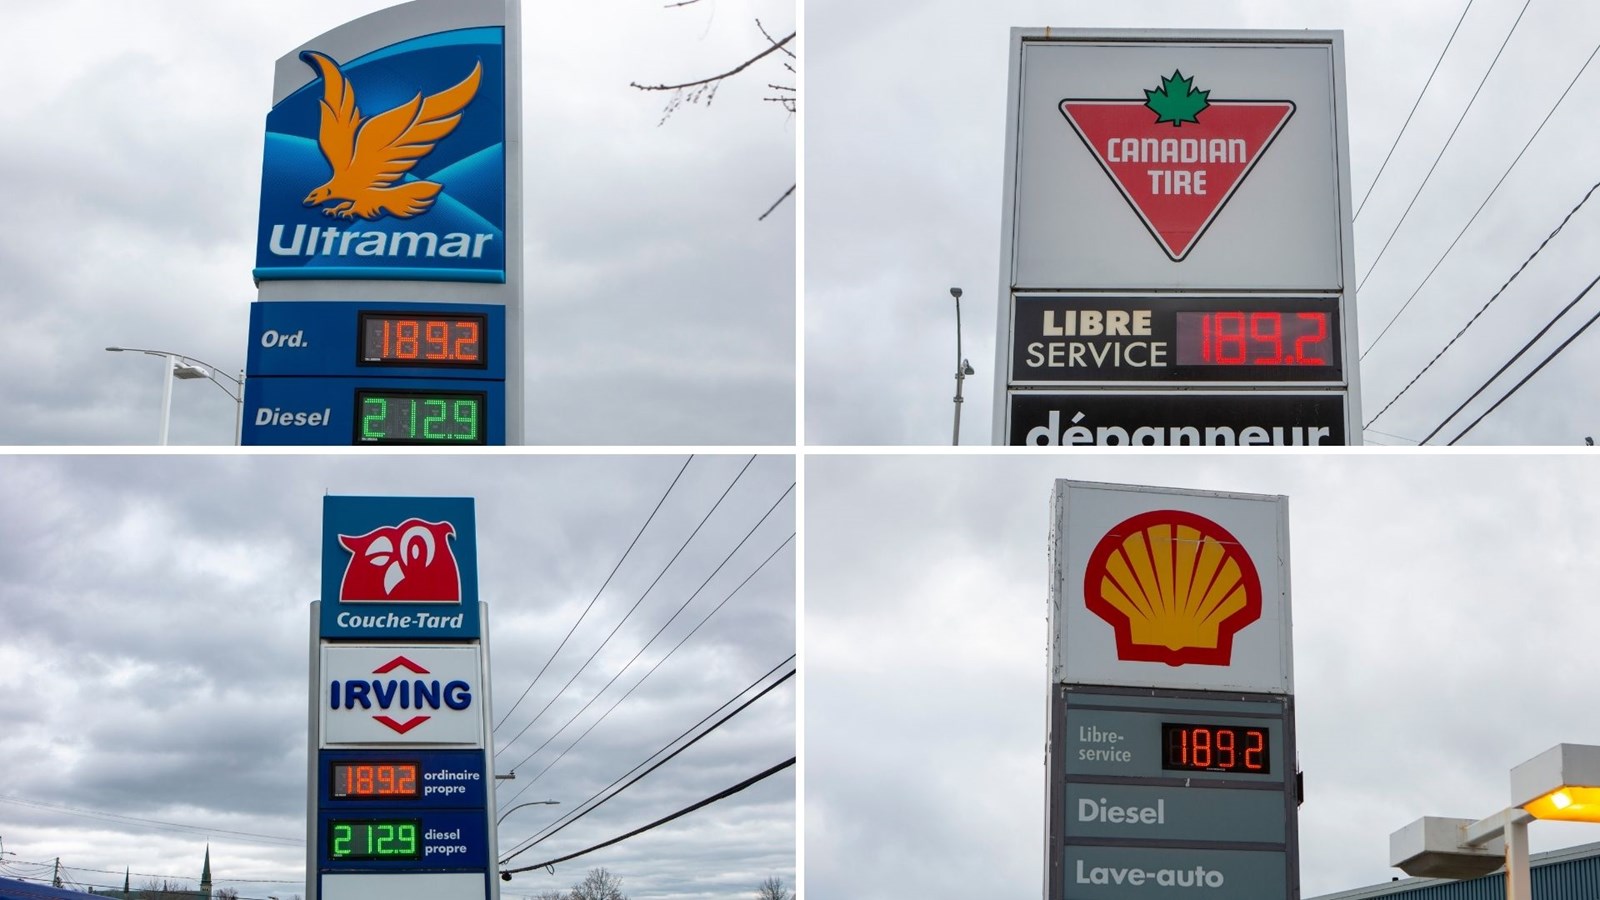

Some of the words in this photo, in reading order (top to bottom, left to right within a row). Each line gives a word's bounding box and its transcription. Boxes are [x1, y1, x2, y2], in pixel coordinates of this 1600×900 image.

[1107, 137, 1247, 164] CANADIAN
[1147, 169, 1207, 195] TIRE
[269, 223, 493, 258] Ultramar
[1042, 310, 1152, 336] LIBRE
[261, 329, 308, 348] Ord.
[383, 320, 478, 360] 189.2
[1201, 311, 1327, 365] 189.2
[1026, 341, 1168, 368] SERVICE
[255, 407, 331, 426] Diesel
[363, 398, 477, 439] 212.9
[337, 612, 464, 629] Couche-Tard
[330, 679, 472, 711] IRVING
[1079, 725, 1124, 743] Libre-
[1078, 746, 1131, 763] service
[346, 766, 416, 794] 189.2
[424, 769, 480, 781] ordinaire
[424, 785, 466, 796] propre
[1078, 797, 1165, 824] Diesel
[334, 825, 415, 854] 212.9
[424, 829, 461, 840] diesel
[424, 844, 467, 856] propre
[1076, 859, 1224, 888] Lave-auto
